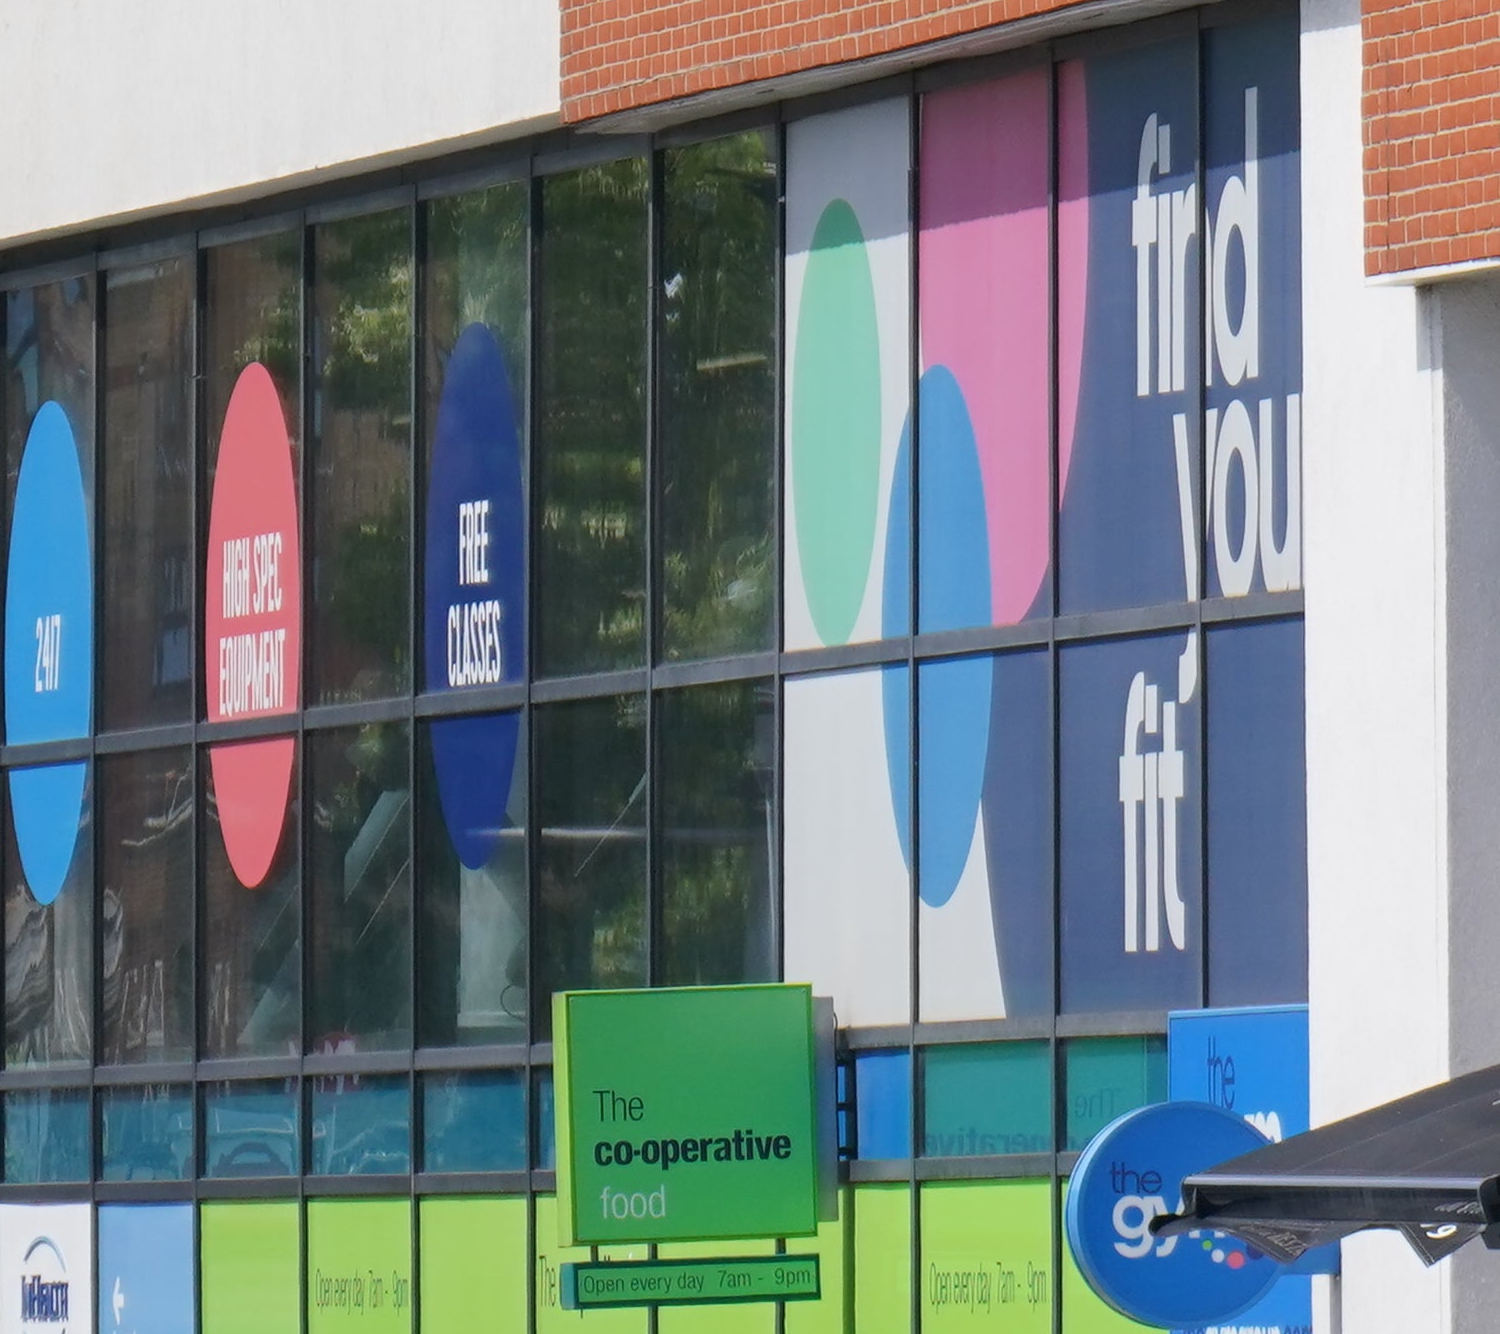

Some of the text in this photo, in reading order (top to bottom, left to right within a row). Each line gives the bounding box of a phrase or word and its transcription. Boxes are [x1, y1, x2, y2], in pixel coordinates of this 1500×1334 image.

[1132, 86, 1258, 396] find
[459, 500, 489, 585] FREE
[223, 532, 282, 618] HIGH SPEC
[35, 615, 61, 693] 24/7
[219, 628, 285, 717] EQUIPMENT
[448, 600, 500, 688] CLASSES
[1119, 671, 1185, 953] fit
[1206, 1036, 1235, 1110] the
[592, 1090, 644, 1122] The
[594, 1129, 791, 1170] co-operative
[1110, 1162, 1162, 1194] the
[600, 1184, 666, 1219] food
[316, 1268, 408, 1315] Open every day 7am 9pm
[539, 1255, 557, 1307] The
[584, 1267, 811, 1295] Open every day 7am 9pm
[930, 1261, 1047, 1314] Open every day 7am 9pm
